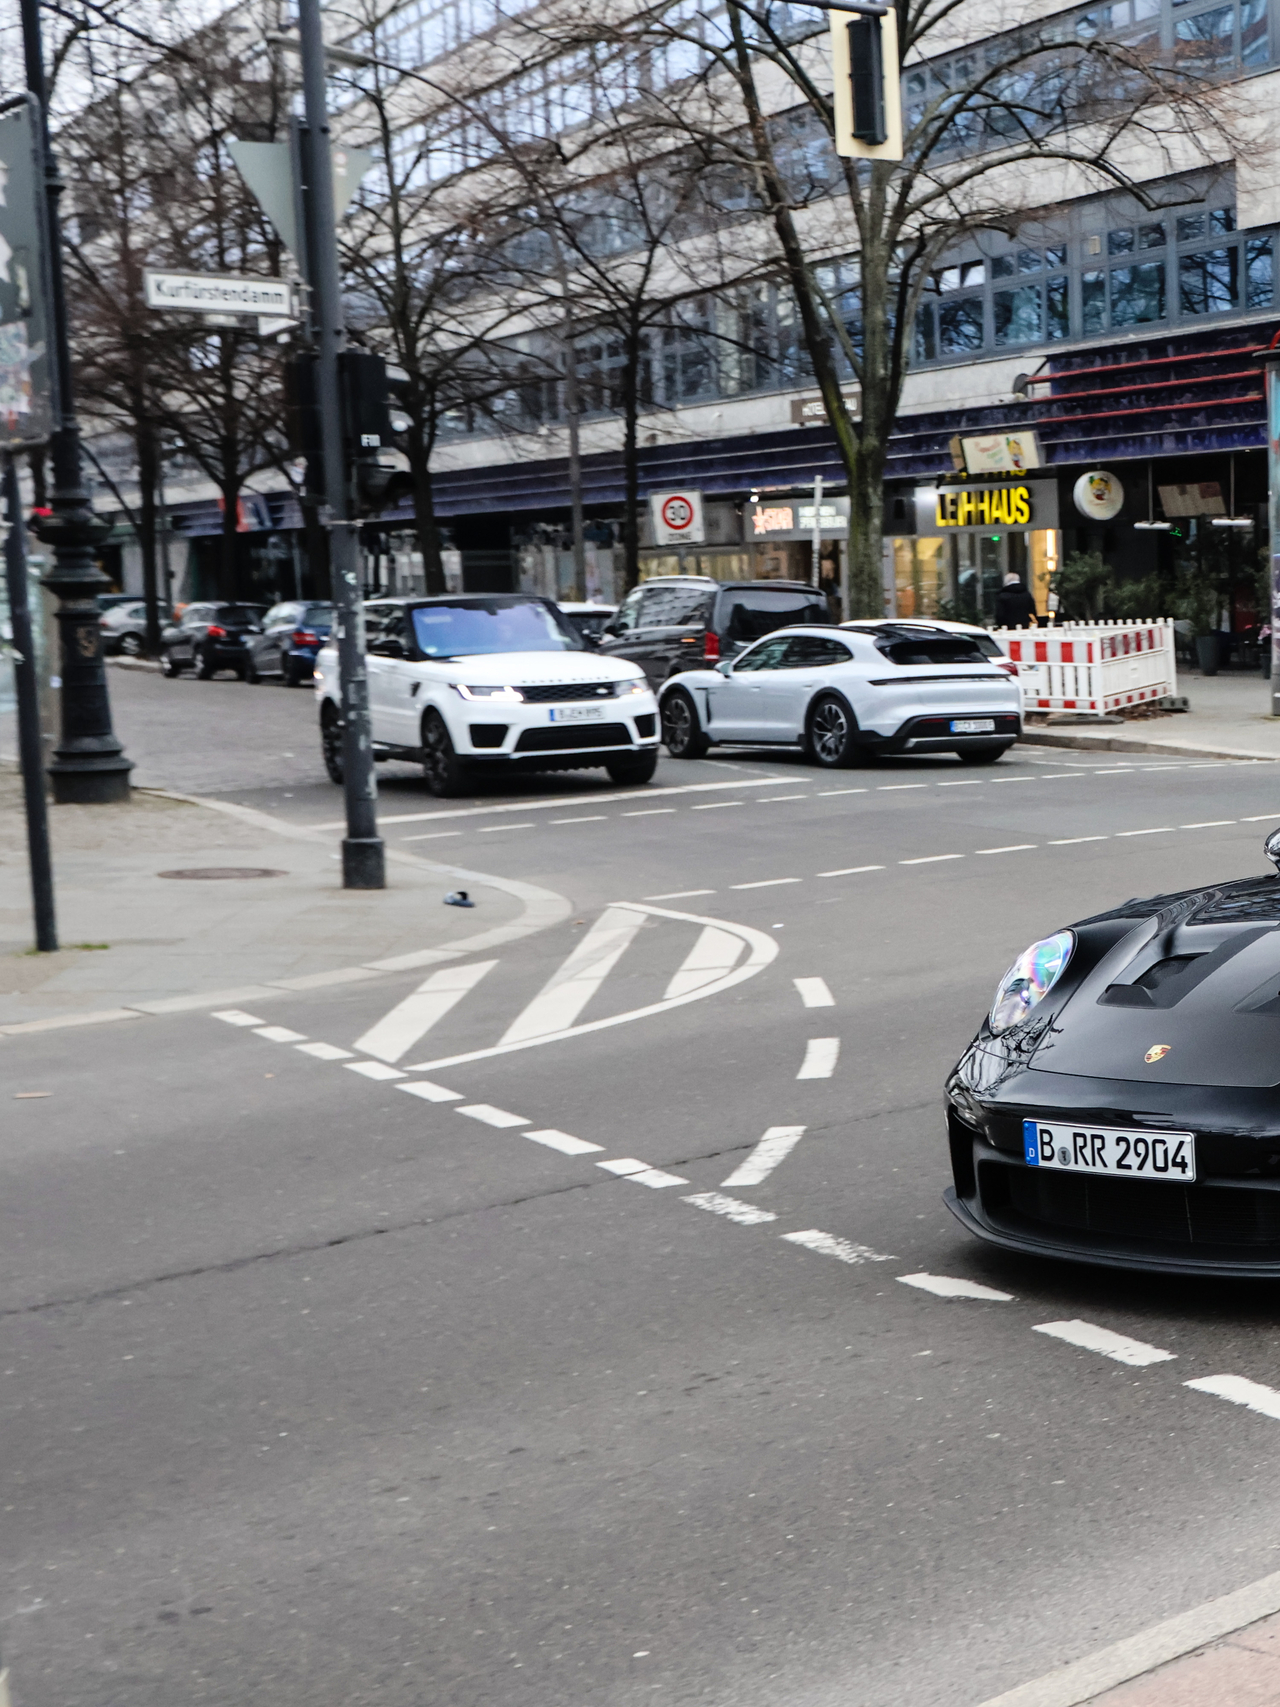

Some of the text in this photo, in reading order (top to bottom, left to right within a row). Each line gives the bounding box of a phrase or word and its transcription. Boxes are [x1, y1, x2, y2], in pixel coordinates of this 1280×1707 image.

[668, 504, 690, 521] 30
[935, 486, 1031, 527] LEIHHAUS
[1039, 1128, 1055, 1162] B
[1073, 1131, 1109, 1168] RR
[1115, 1136, 1189, 1175] 2904
